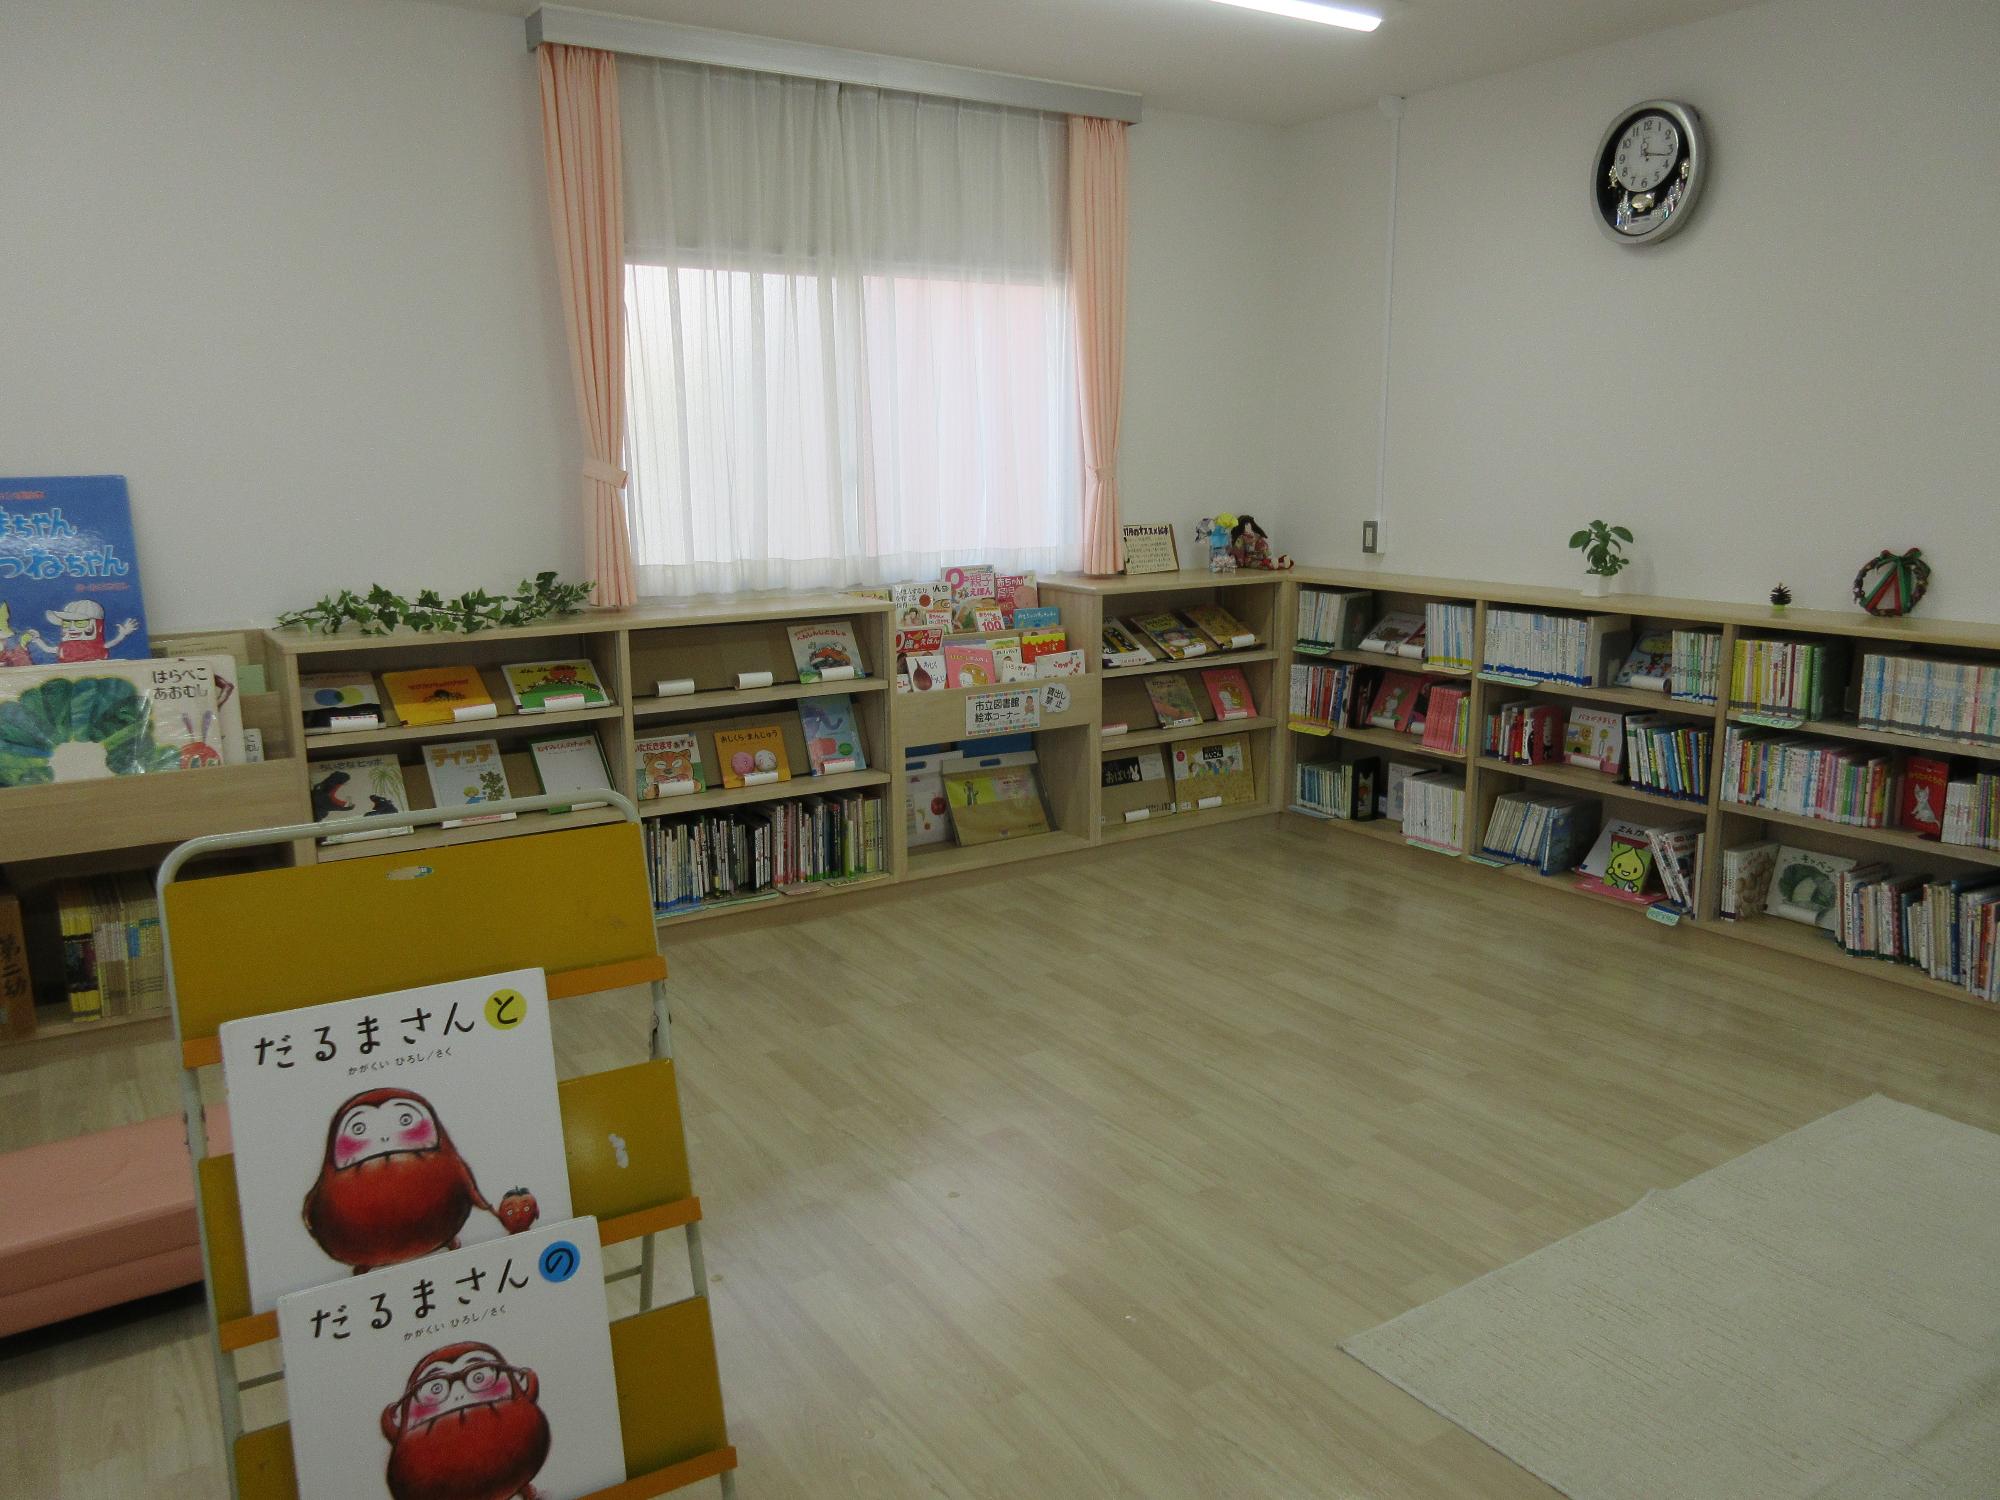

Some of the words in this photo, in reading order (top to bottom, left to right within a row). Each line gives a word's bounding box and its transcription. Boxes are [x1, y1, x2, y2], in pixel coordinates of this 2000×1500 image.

[1643, 120, 1653, 131] 12
[1658, 121, 1662, 131] 1
[1632, 126, 1639, 137] 11
[1665, 129, 1671, 140] 2
[1622, 138, 1631, 149] 10
[1666, 144, 1674, 155] 3
[1619, 154, 1625, 165] 9
[1663, 159, 1669, 169] 4
[1622, 167, 1628, 177] 8
[1654, 171, 1660, 182] 5
[1631, 176, 1636, 187] 7
[1641, 177, 1648, 188] 6
[982, 621, 1002, 632] 100
[153, 684, 208, 701] あおむし
[975, 697, 1020, 711] 市立図書館
[975, 711, 1020, 723] 絵本コーナー
[431, 744, 494, 767] ティッチ
[254, 996, 519, 1069] だるまさんと
[347, 1060, 390, 1076] かがくい
[310, 1246, 575, 1340] だるまさんの
[403, 1322, 445, 1342] かがくい
